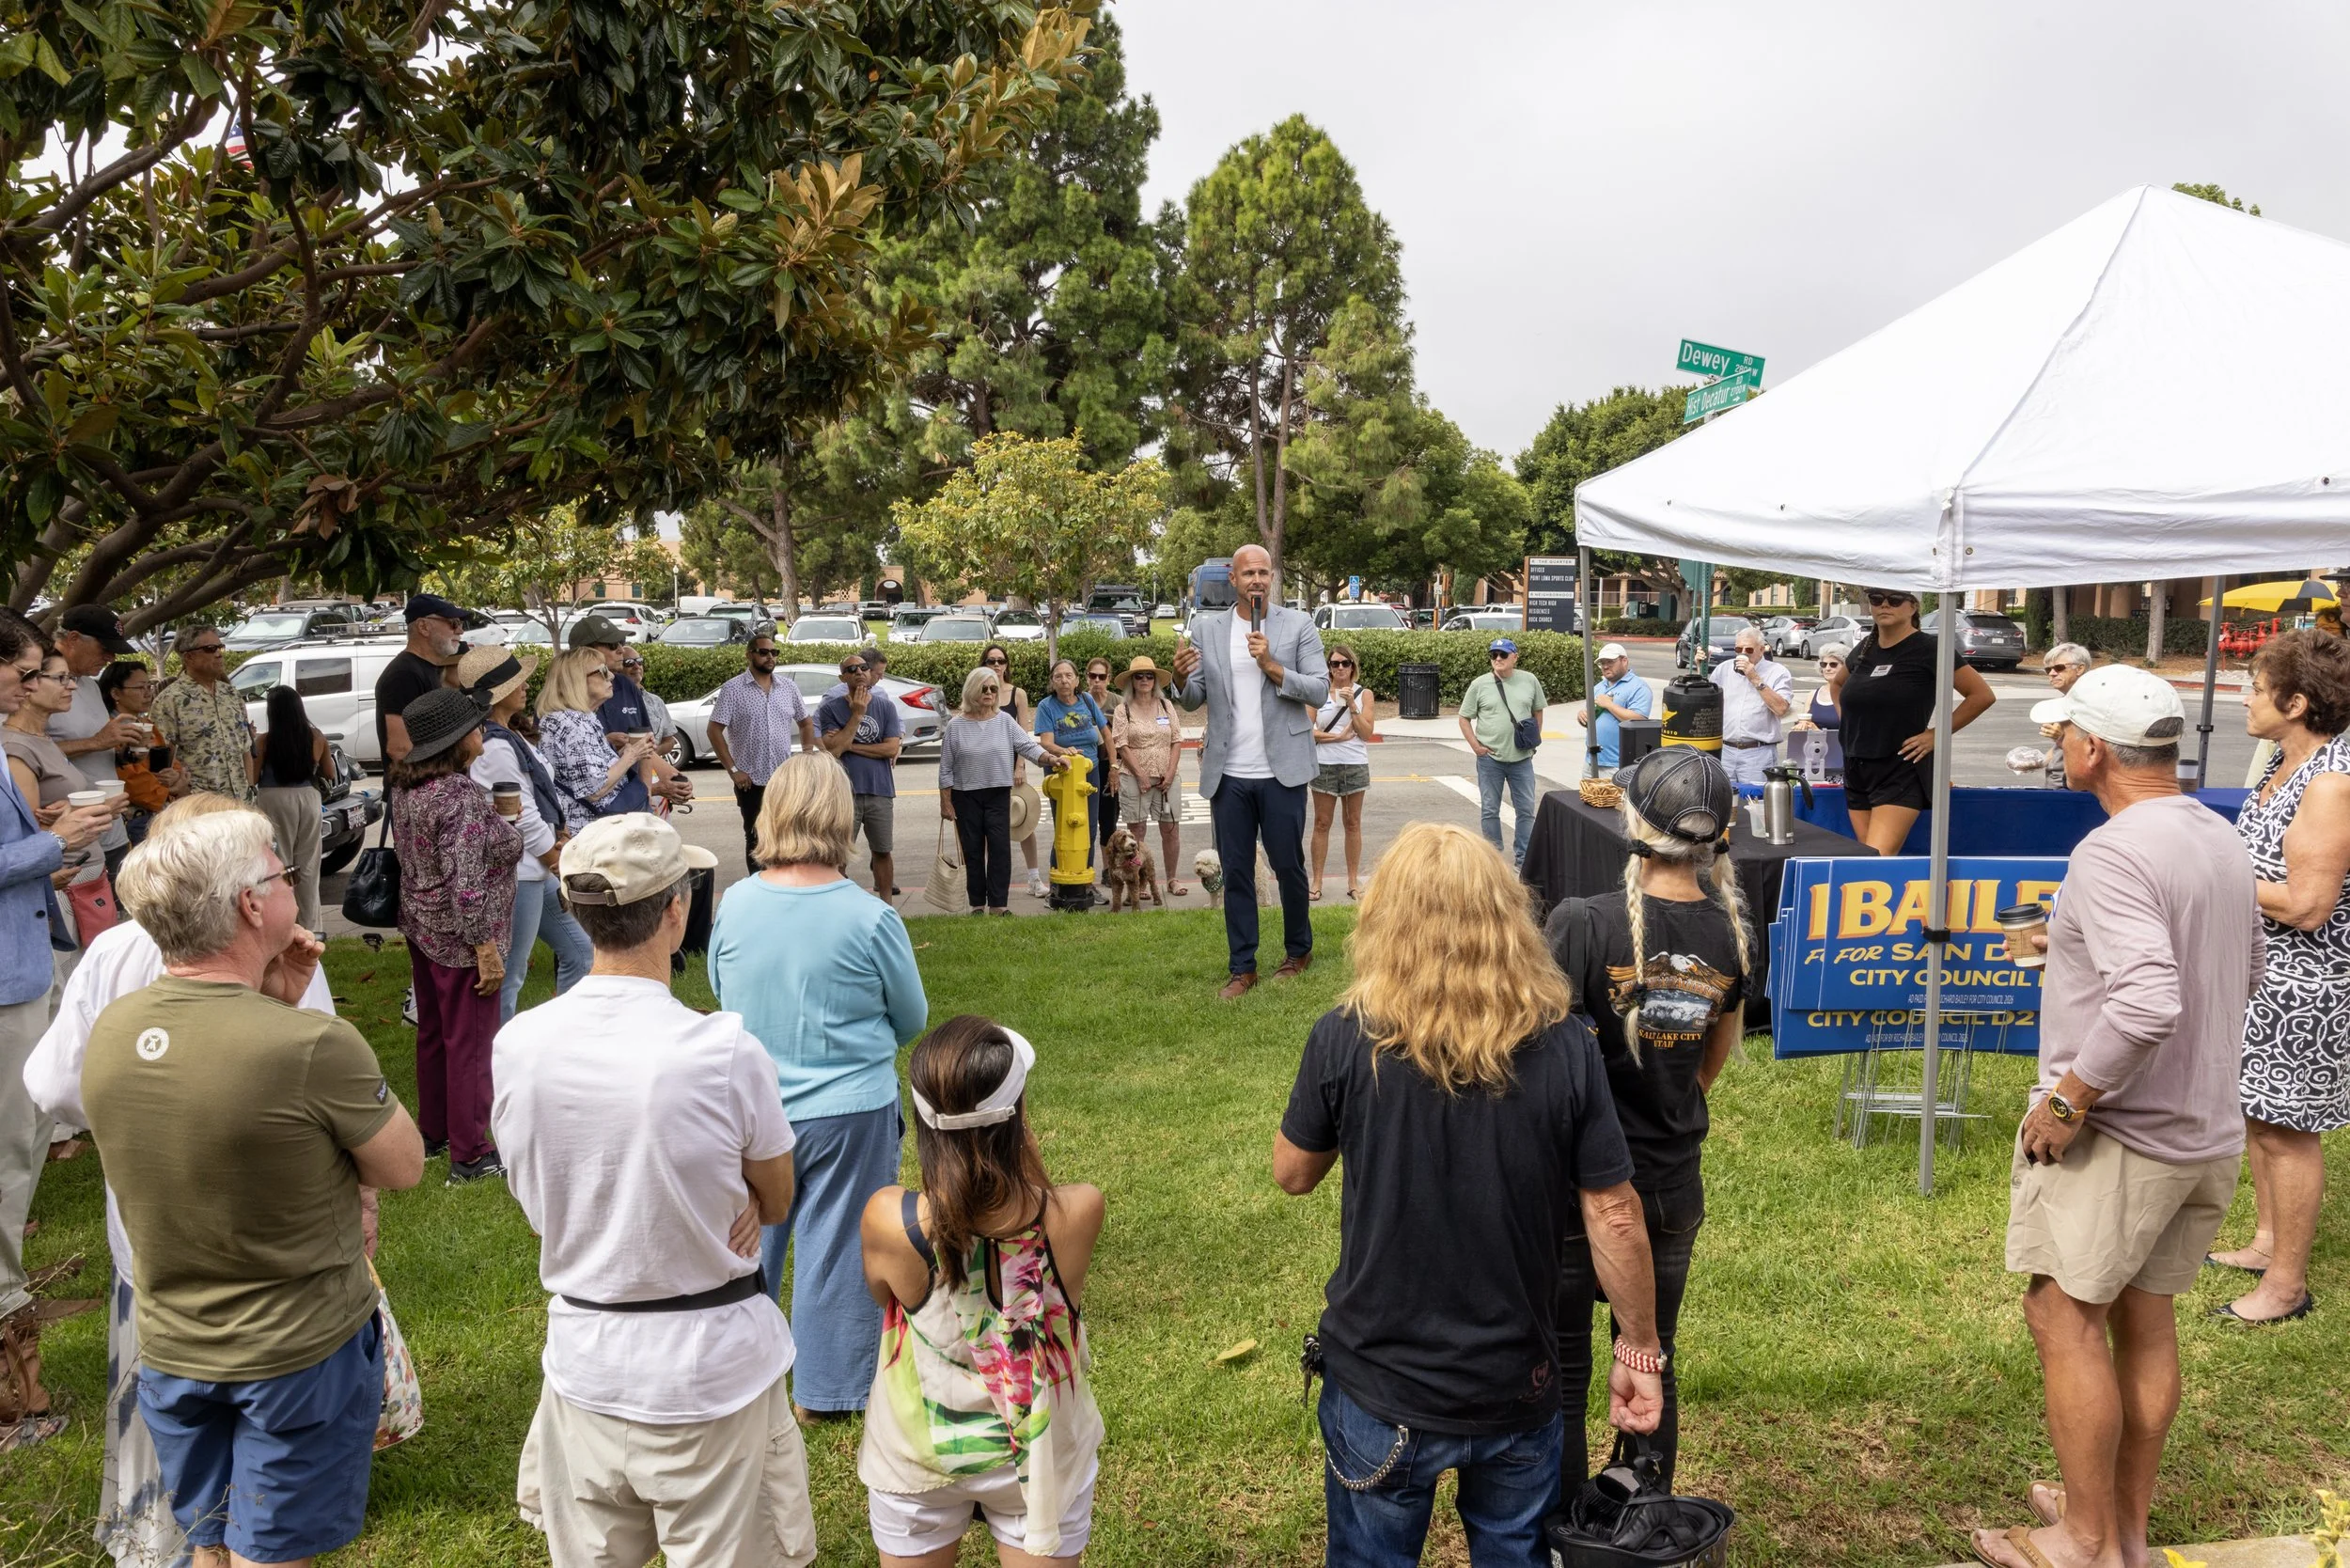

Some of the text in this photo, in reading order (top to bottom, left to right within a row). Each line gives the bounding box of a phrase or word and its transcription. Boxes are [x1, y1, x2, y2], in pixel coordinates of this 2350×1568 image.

[1682, 342, 1731, 376] Dewey
[1743, 356, 1752, 365] RD
[1685, 386, 1731, 417] Hist Decatur
[1834, 945, 1884, 964] FOR
[1849, 968, 1909, 986] CITY
[1985, 994, 2003, 1005] COUNCIL
[1807, 1011, 1865, 1027] CITY
[1991, 1011, 2035, 1027] D2
[1638, 1028, 1702, 1041] SALT LAKE CITY
[1653, 1040, 1674, 1048] UTAH
